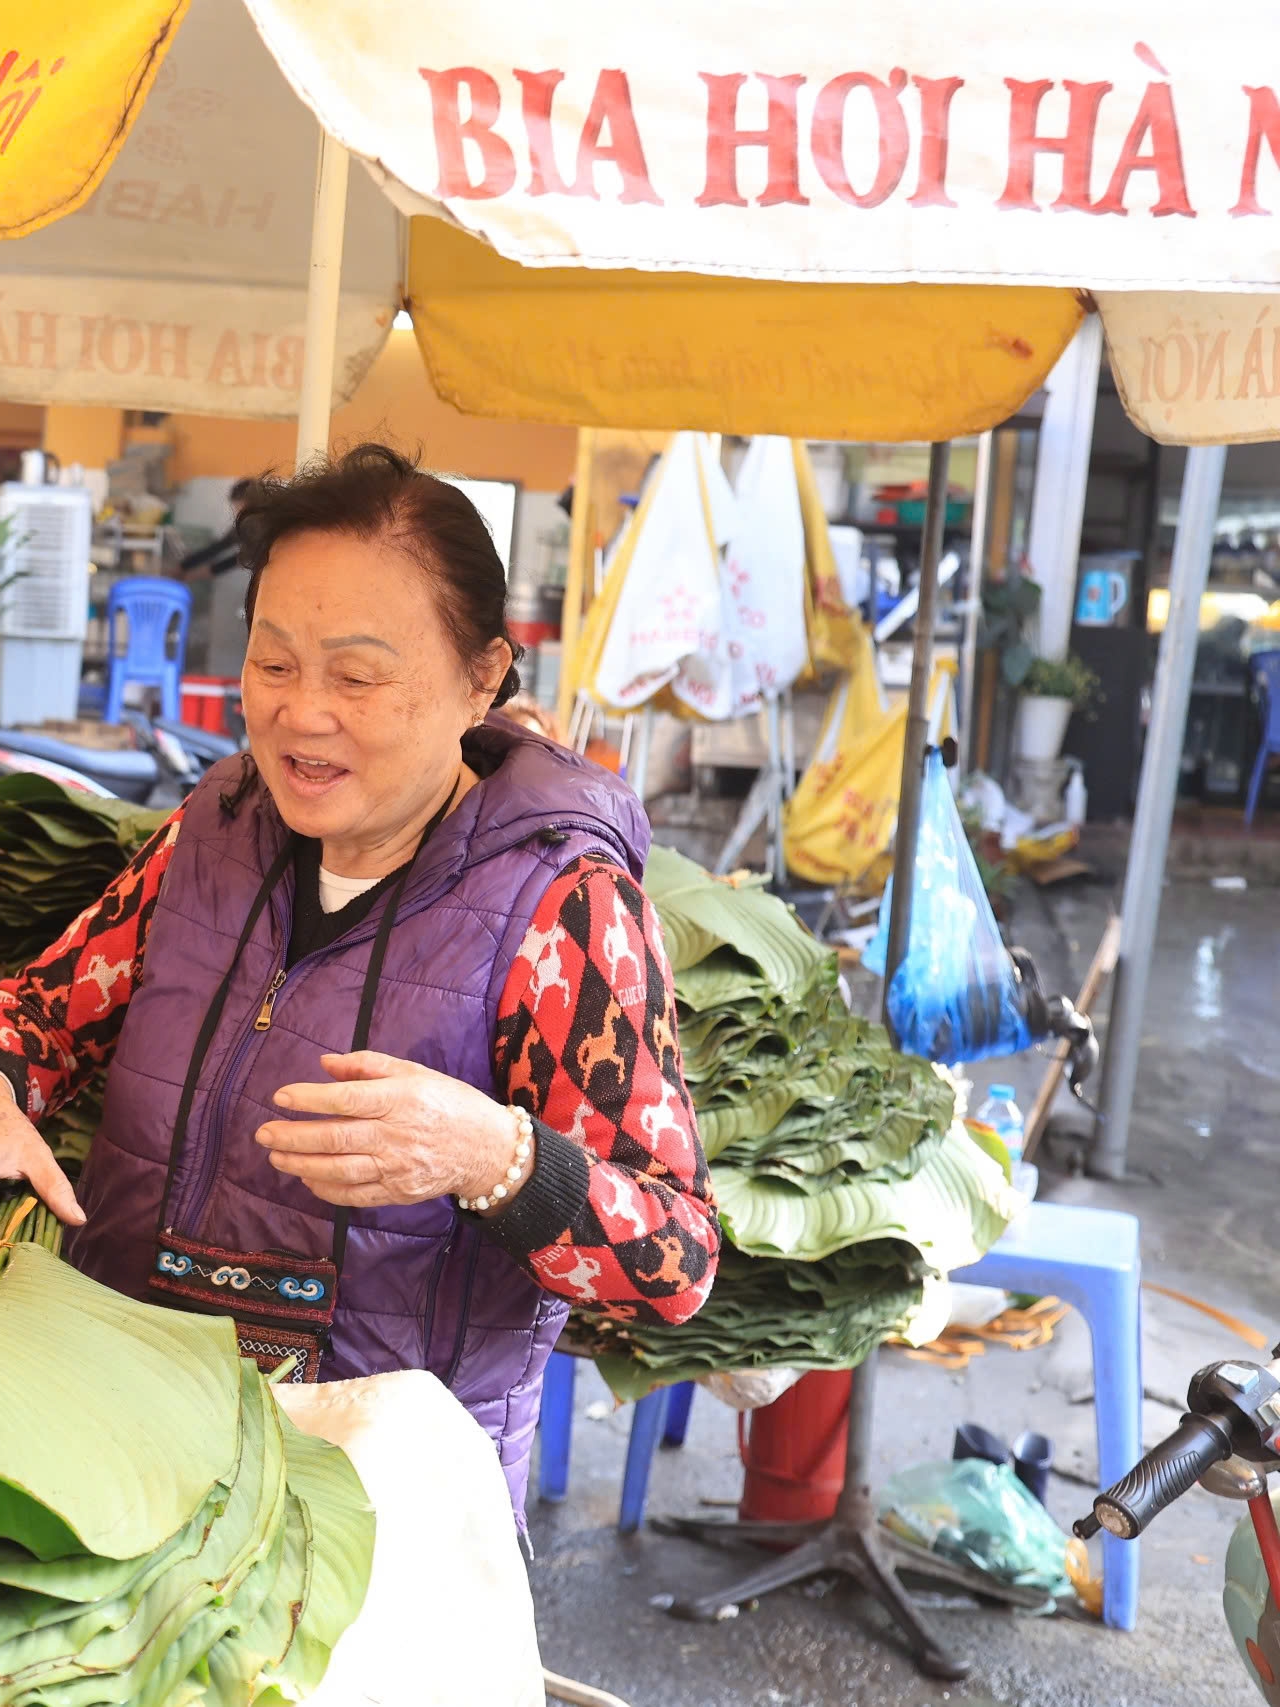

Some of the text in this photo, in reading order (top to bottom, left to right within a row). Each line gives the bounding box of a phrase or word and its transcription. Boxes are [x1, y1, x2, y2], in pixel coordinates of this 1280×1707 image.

[419, 66, 663, 205] BIA
[695, 66, 966, 209] HƠI
[995, 41, 1198, 218] HÀ
